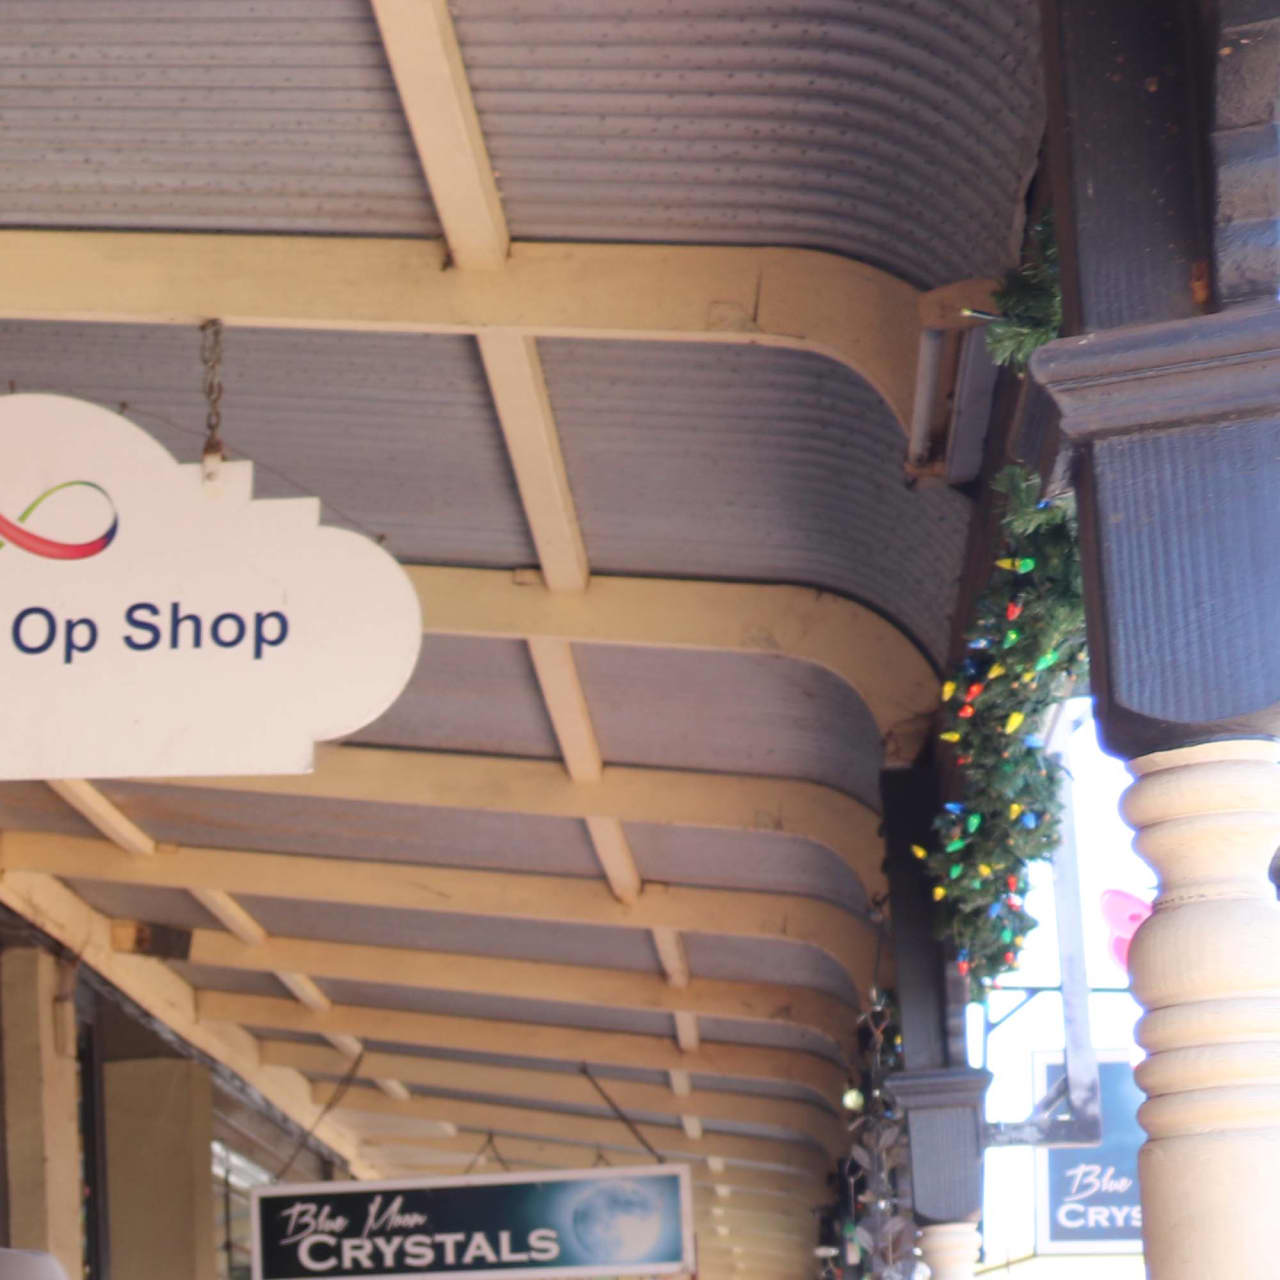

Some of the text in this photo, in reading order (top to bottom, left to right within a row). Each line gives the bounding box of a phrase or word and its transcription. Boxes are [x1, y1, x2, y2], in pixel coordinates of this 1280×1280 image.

[10, 606, 98, 663] Op
[123, 602, 290, 659] Shop
[1064, 1163, 1132, 1202] Blue
[279, 1194, 428, 1246] Blue Moon
[1056, 1203, 1143, 1229] CRYS
[297, 1227, 561, 1272] CRYSTALS
